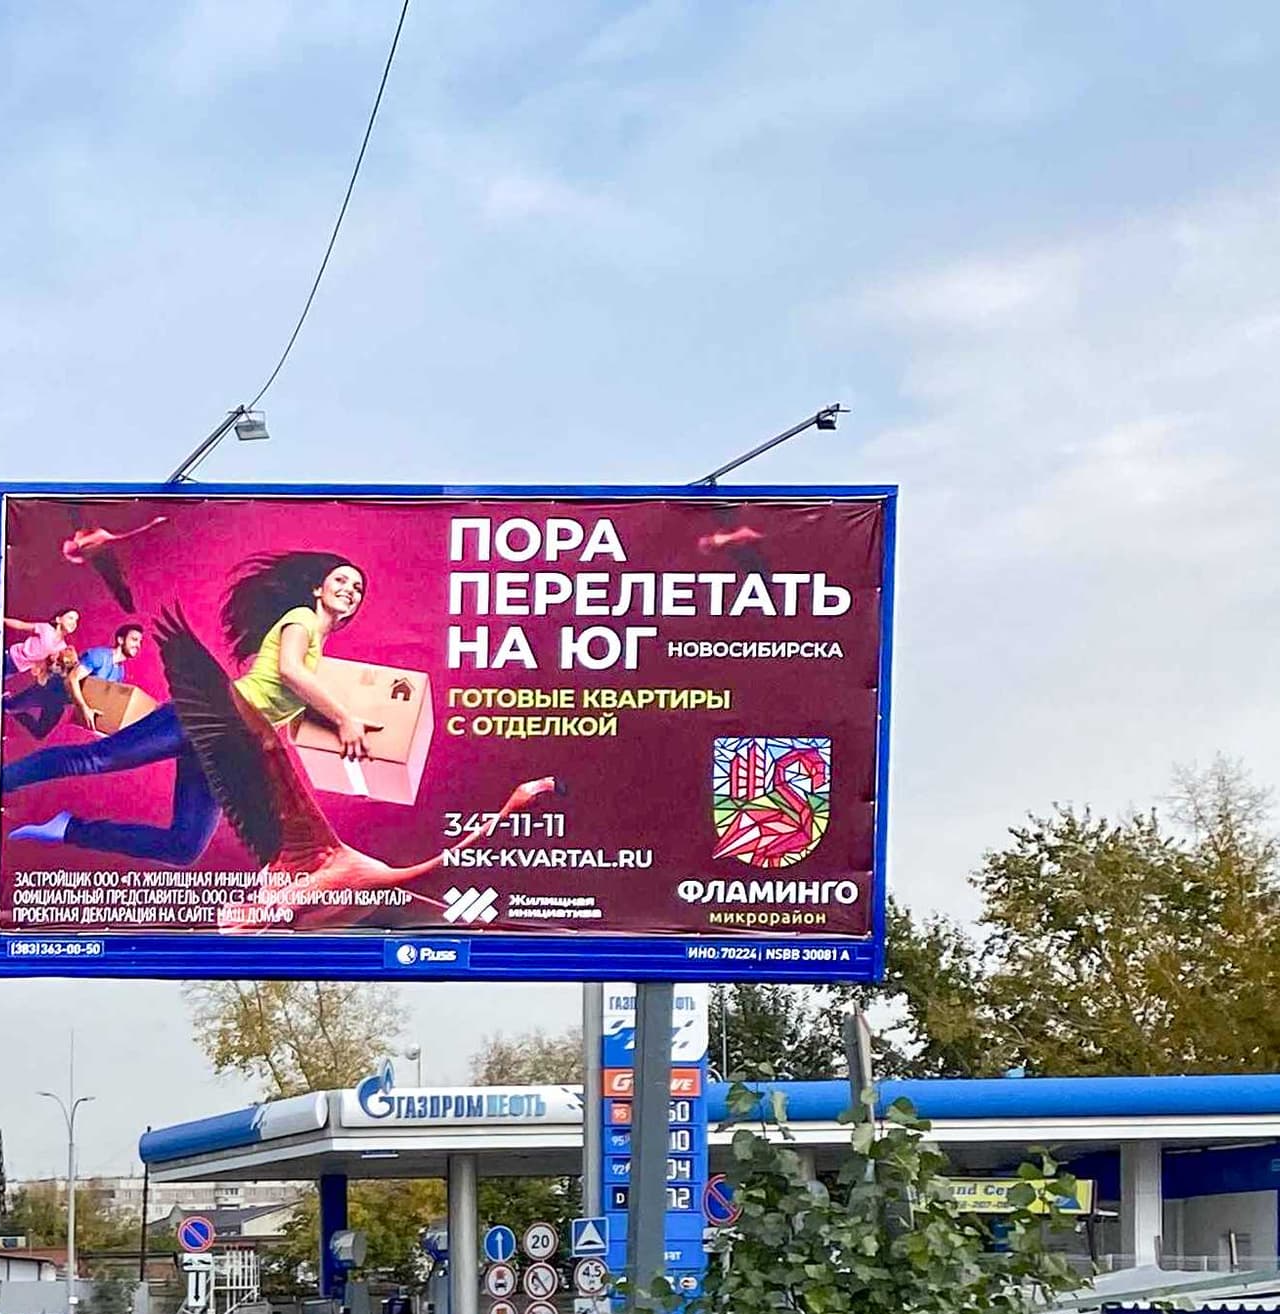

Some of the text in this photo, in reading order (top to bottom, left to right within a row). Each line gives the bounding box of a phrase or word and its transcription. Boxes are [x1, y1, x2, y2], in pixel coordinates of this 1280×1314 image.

[450, 517, 628, 563] ПОРА
[448, 572, 852, 617] ПЕРЕЛЕТАТЬ
[447, 625, 843, 671] НА ЮГ НОВОСИБИРСКА
[448, 689, 731, 710] ГОТОВЫЕ КВАРТИРЫ
[447, 712, 618, 739] С ОТДЕЛКОЙ
[443, 812, 566, 838] 347-11-11
[442, 849, 653, 869] NSK-KVARTAL.RU
[14, 870, 92, 888] ЗАСТРОЙЩИК
[93, 872, 119, 887] ООО
[142, 872, 213, 888] ЖИЛИЩНАЯ
[214, 871, 292, 888] ИНИЦИАТИВА
[13, 888, 104, 906] ОФИЦИАЛЬНЫЙ
[106, 890, 201, 906] ПРЕДСТАВИТЕЛЬ
[202, 890, 228, 905] ООО
[508, 894, 595, 908] Жилищная
[677, 880, 859, 905] ФЛАМИНГО
[12, 906, 80, 923] ПРОЕКТНАЯ
[81, 907, 157, 924] ДЕКЛАРАЦИЯ
[158, 907, 176, 922] НА
[177, 905, 215, 922] САЙТЕ
[709, 910, 827, 927] микрорайон
[419, 947, 458, 962] Russ
[395, 1093, 547, 1119] ГАЗПРОМНЕФТЬ
[531, 1235, 550, 1249] 20
